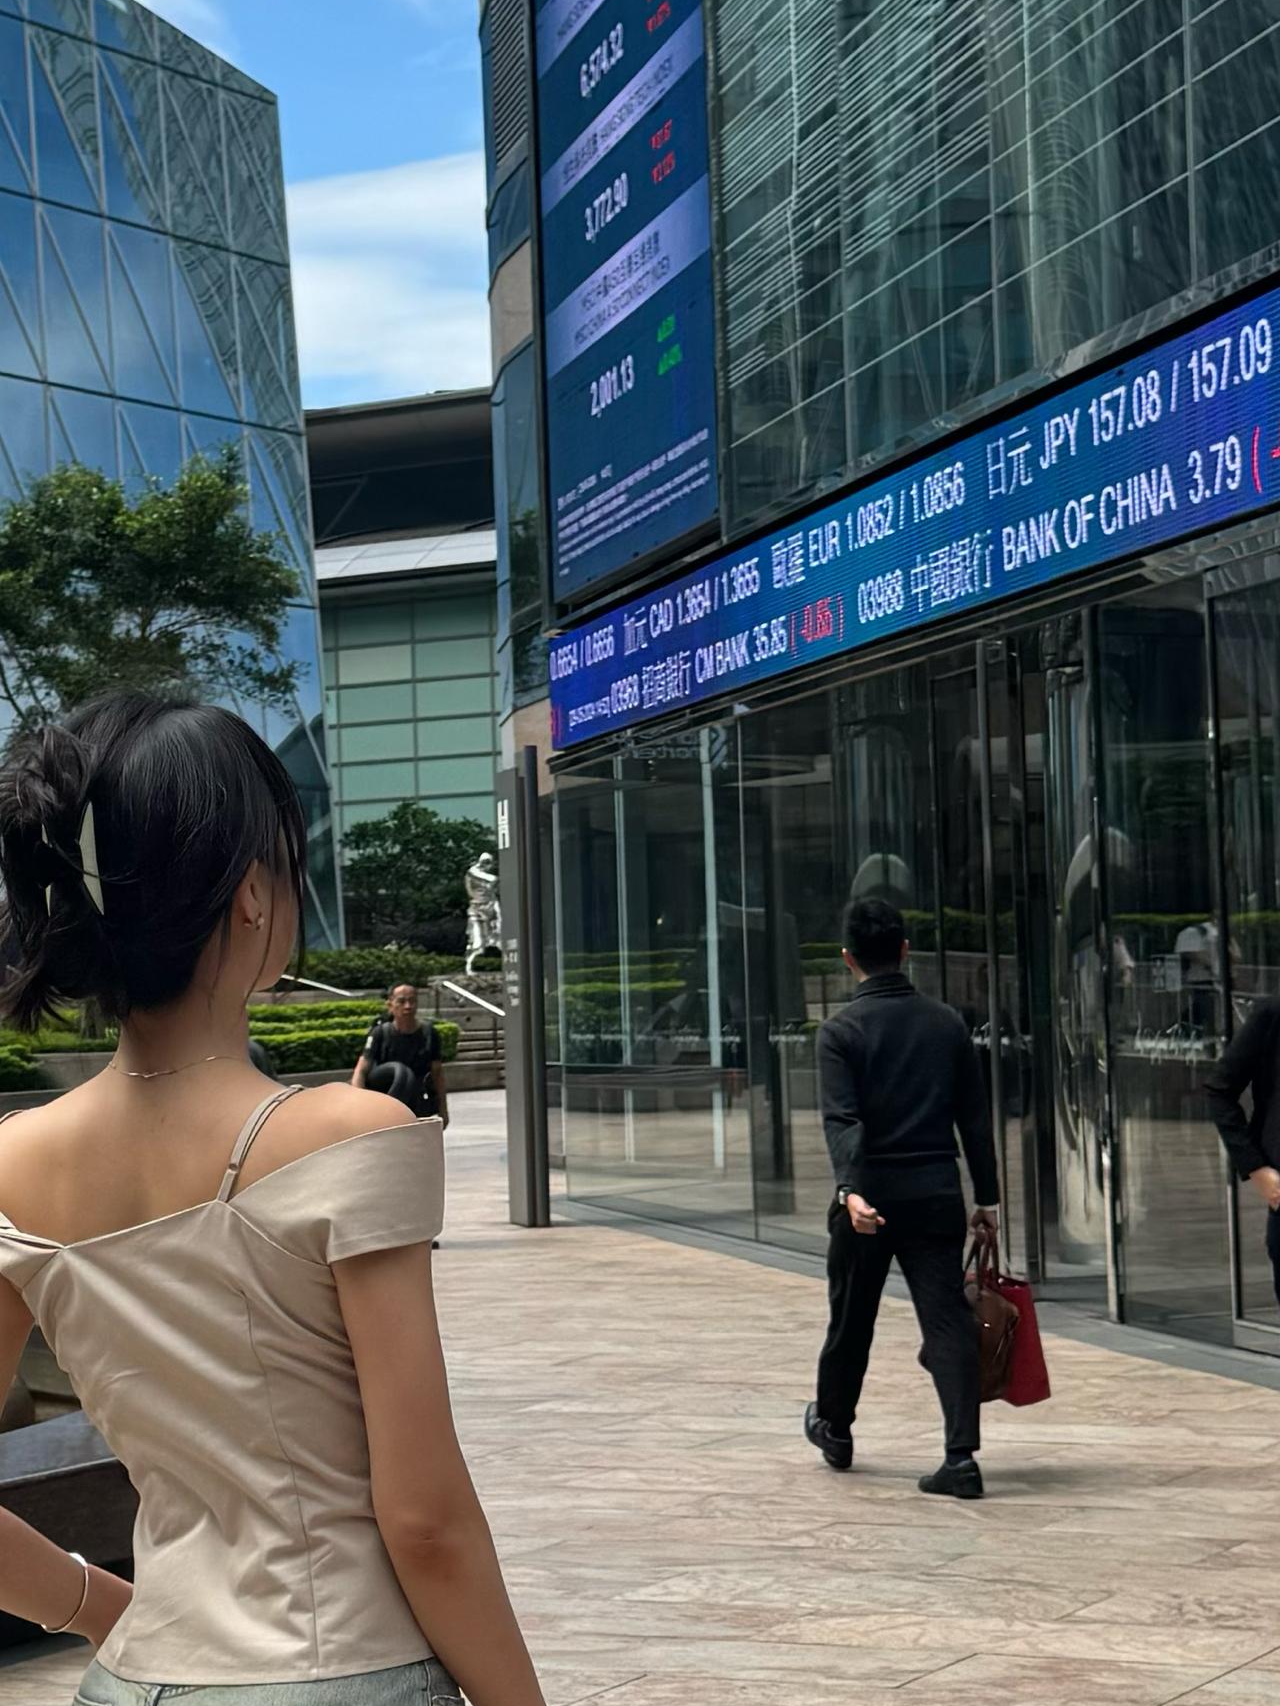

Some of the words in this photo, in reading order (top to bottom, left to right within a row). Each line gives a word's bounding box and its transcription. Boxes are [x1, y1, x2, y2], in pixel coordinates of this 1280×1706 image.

[589, 354, 635, 418] 2,001.13
[649, 598, 672, 639] CAD
[808, 519, 841, 567] EUR
[985, 426, 1034, 500] 日元
[1038, 407, 1081, 471] JPY
[1087, 369, 1161, 447] 157.08
[1186, 318, 1273, 403] 157.09
[715, 629, 752, 677] BANK
[909, 528, 994, 613] 中國銀行
[1001, 506, 1062, 573] BANK
[1063, 494, 1095, 549] OF
[1098, 462, 1178, 537] CHINA
[1186, 434, 1242, 505] 3.79
